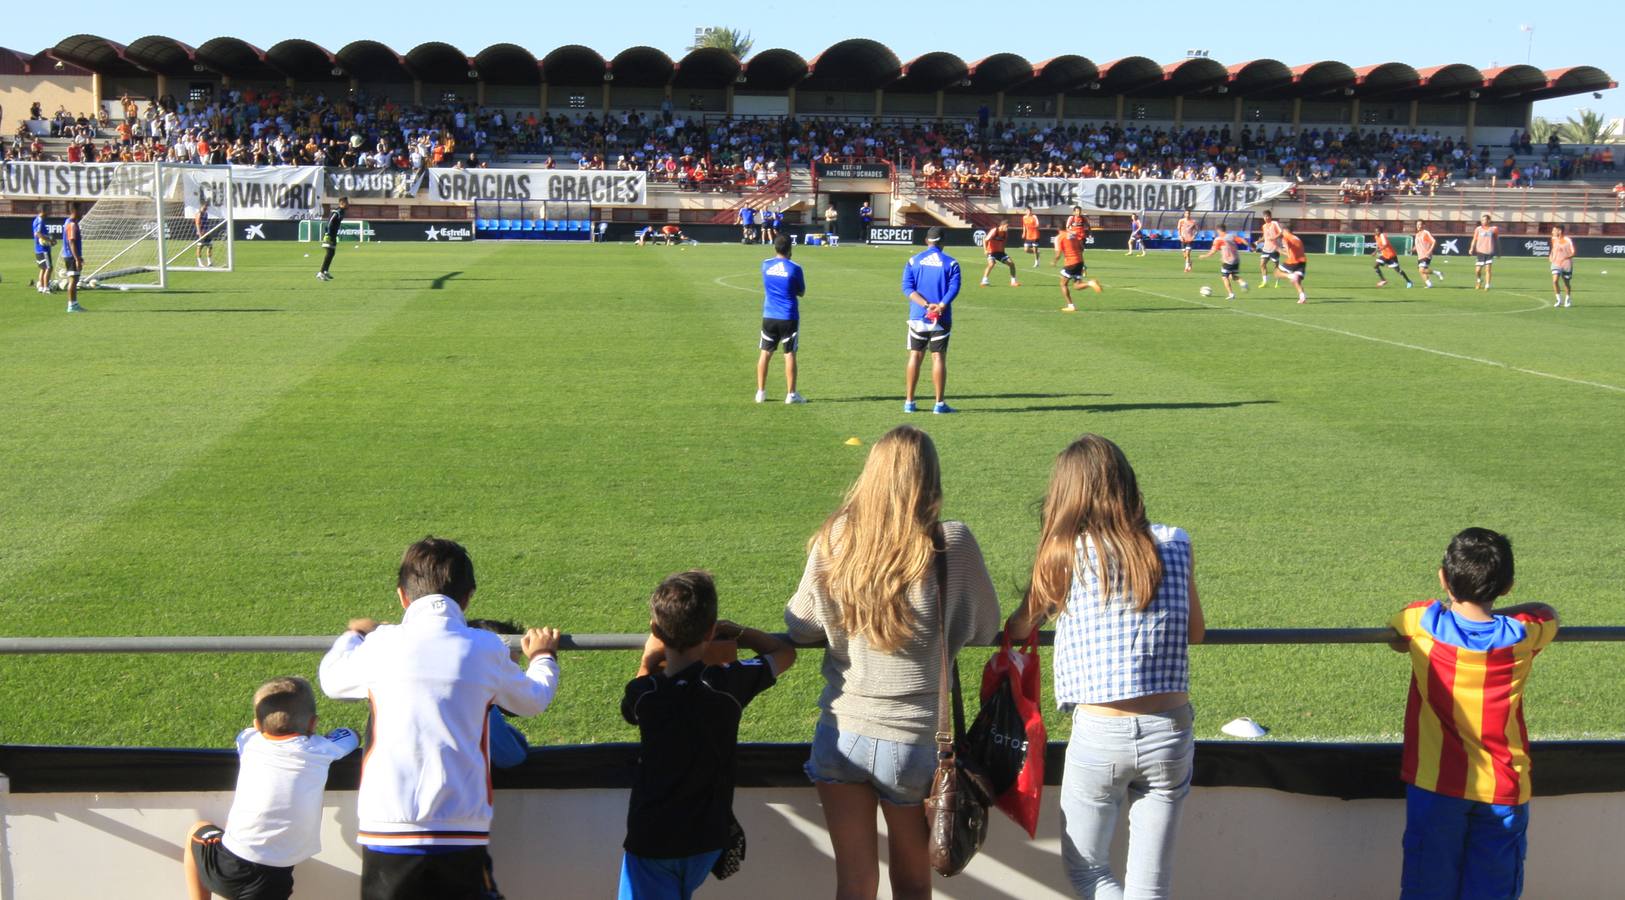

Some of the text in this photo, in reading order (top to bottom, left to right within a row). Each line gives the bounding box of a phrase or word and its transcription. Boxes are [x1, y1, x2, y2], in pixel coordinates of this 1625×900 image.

[332, 173, 393, 191] YOMUS
[439, 173, 639, 203] GRACIAS GRACIES
[1010, 182, 1078, 208] DANKE
[1095, 183, 1197, 210] OBRIGADO
[440, 227, 471, 237] Estrella
[870, 228, 913, 241] RESPECT
